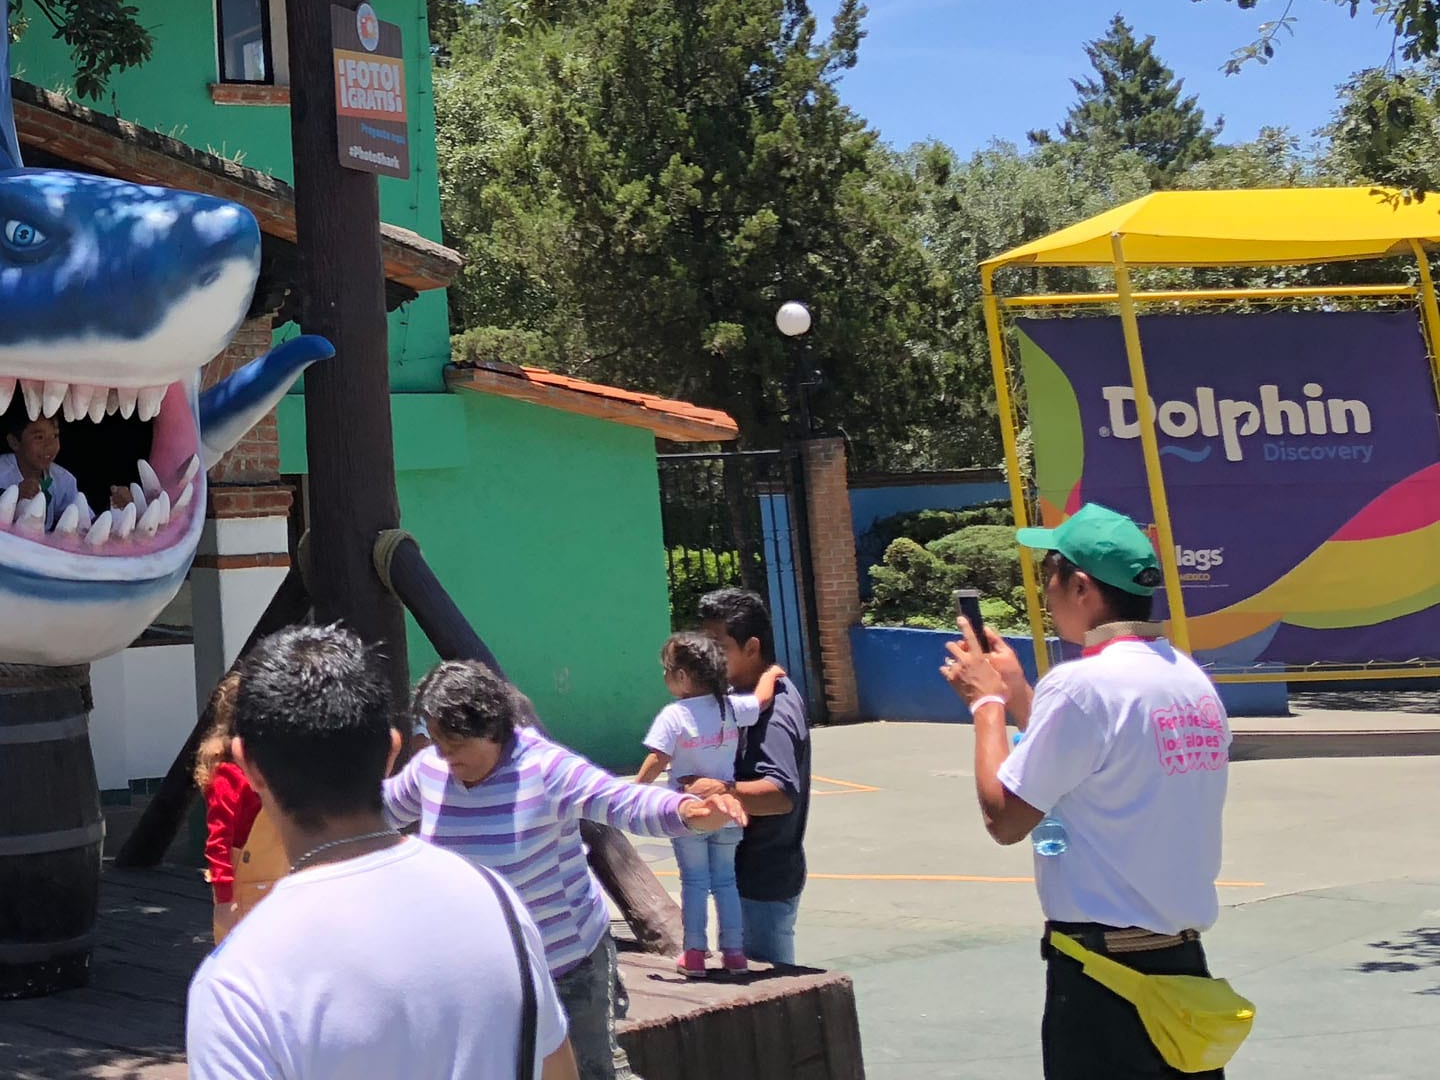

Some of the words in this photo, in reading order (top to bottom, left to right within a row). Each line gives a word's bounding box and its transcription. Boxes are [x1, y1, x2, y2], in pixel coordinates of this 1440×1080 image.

[1102, 383, 1372, 461] Dolphin
[1263, 441, 1374, 463] Discovery
[1175, 544, 1224, 571] lags
